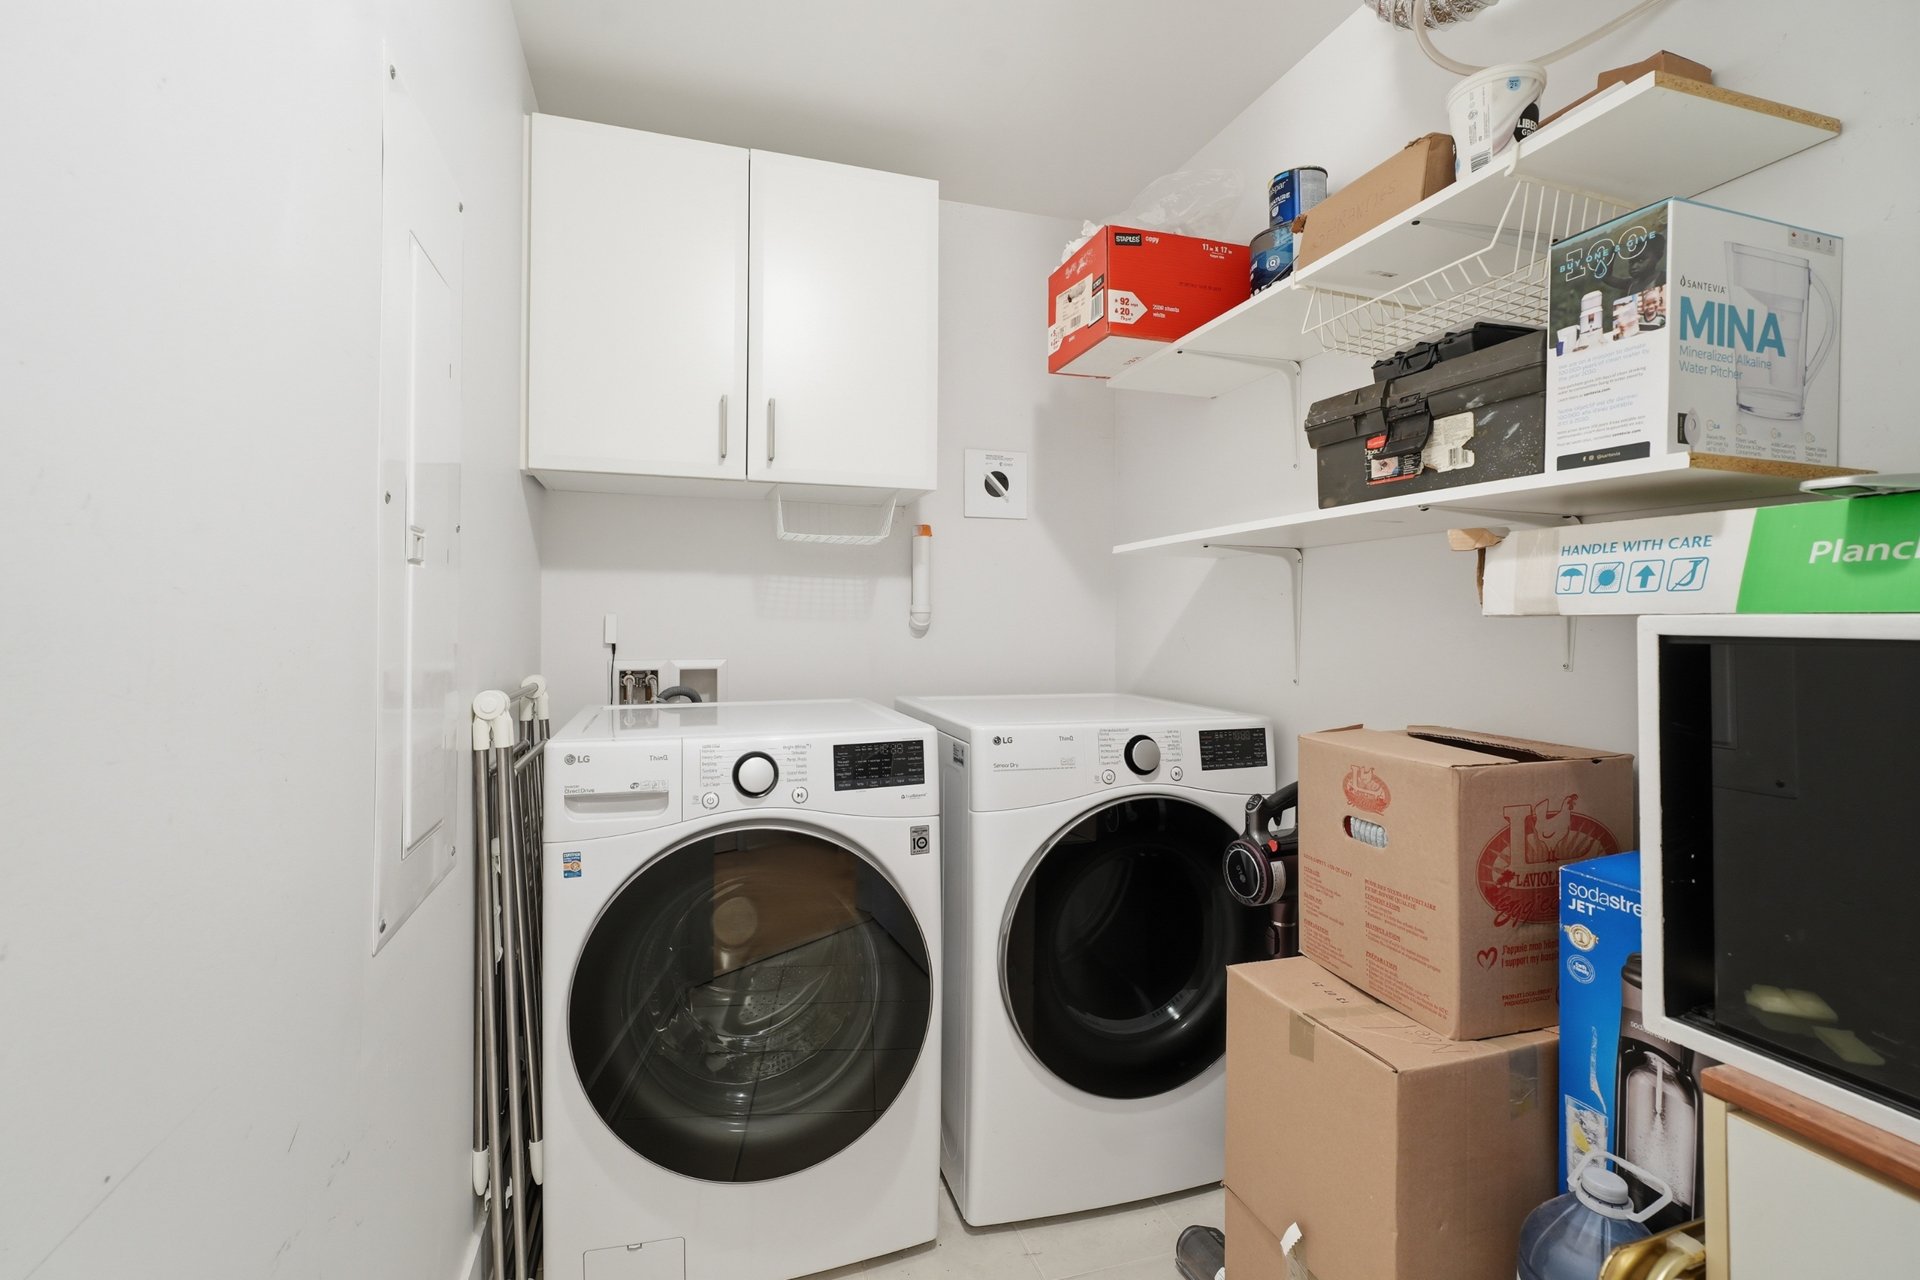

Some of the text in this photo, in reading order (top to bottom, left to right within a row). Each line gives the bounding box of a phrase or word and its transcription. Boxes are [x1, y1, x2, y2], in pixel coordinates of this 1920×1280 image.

[1115, 234, 1159, 244] STAPLES copy
[1202, 243, 1209, 251] 11
[1220, 246, 1228, 254] 17
[1560, 260, 1581, 272] BUY
[1586, 249, 1609, 262] ONE
[1626, 231, 1656, 247] GIVE
[1687, 279, 1727, 295] SANTEVIA
[1120, 297, 1130, 306] 92
[1120, 308, 1130, 316] 20
[1679, 295, 1786, 358] MINA
[1679, 345, 1772, 370] Mineralized Alkaline
[1679, 361, 1743, 380] Water Pitcher
[1561, 534, 1713, 558] HANDLE WITH CARE
[1808, 538, 1920, 564] Planc
[577, 755, 590, 763] LG
[1516, 871, 1560, 888] LAVIOL
[1568, 899, 1596, 916] JET
[1505, 956, 1529, 969] support
[1530, 955, 1540, 965] my
